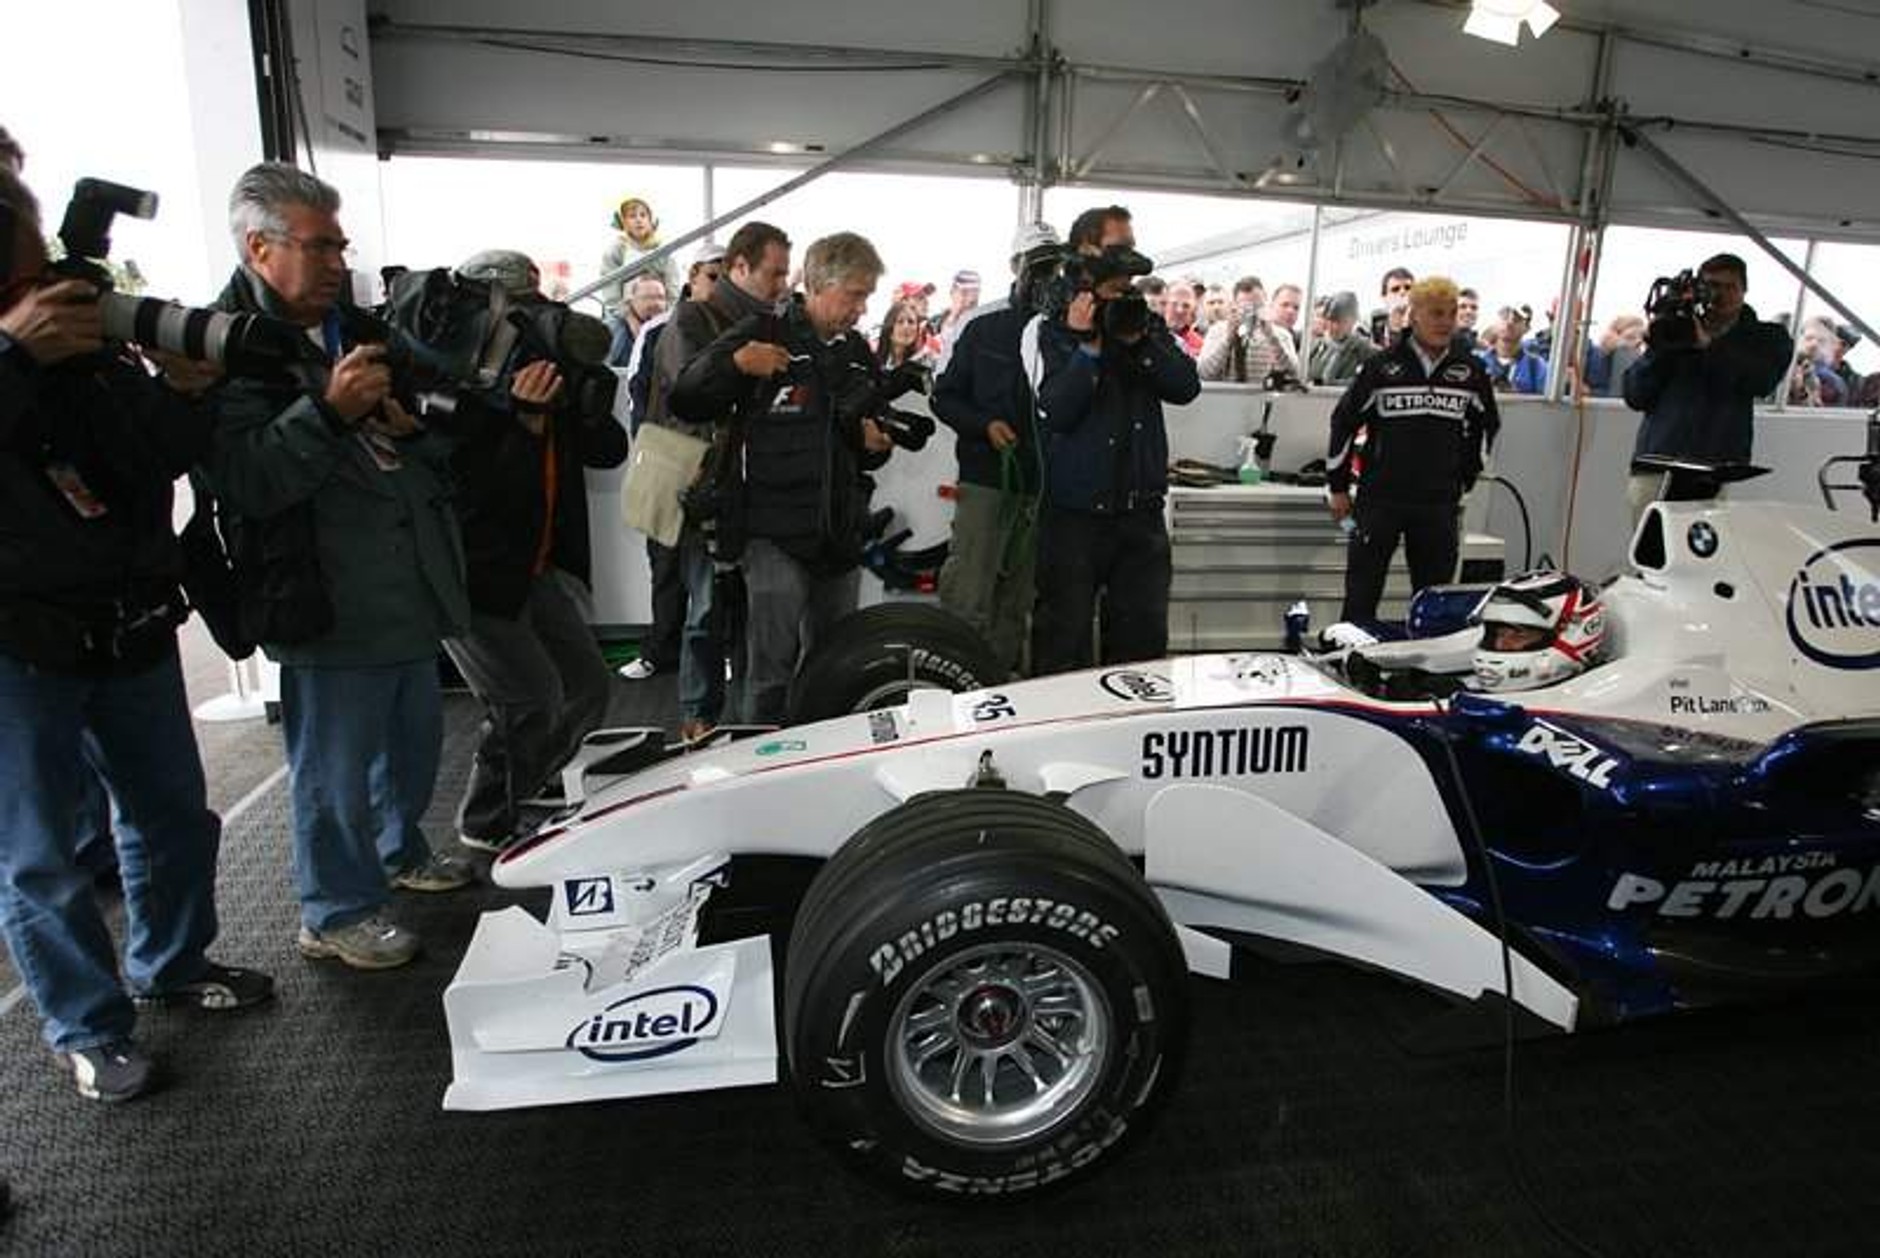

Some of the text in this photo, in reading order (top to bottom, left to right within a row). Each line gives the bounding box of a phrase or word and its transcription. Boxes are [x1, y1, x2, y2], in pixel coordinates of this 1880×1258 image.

[1403, 222, 1468, 250] Lounge
[1670, 695, 1696, 713] Pit
[1142, 725, 1309, 779] SYNTIUM
[1516, 716, 1619, 790] DELL
[1691, 850, 1837, 878] MALAYSIA
[868, 898, 1120, 986] BRIDGESTONE
[587, 1001, 693, 1043] intel
